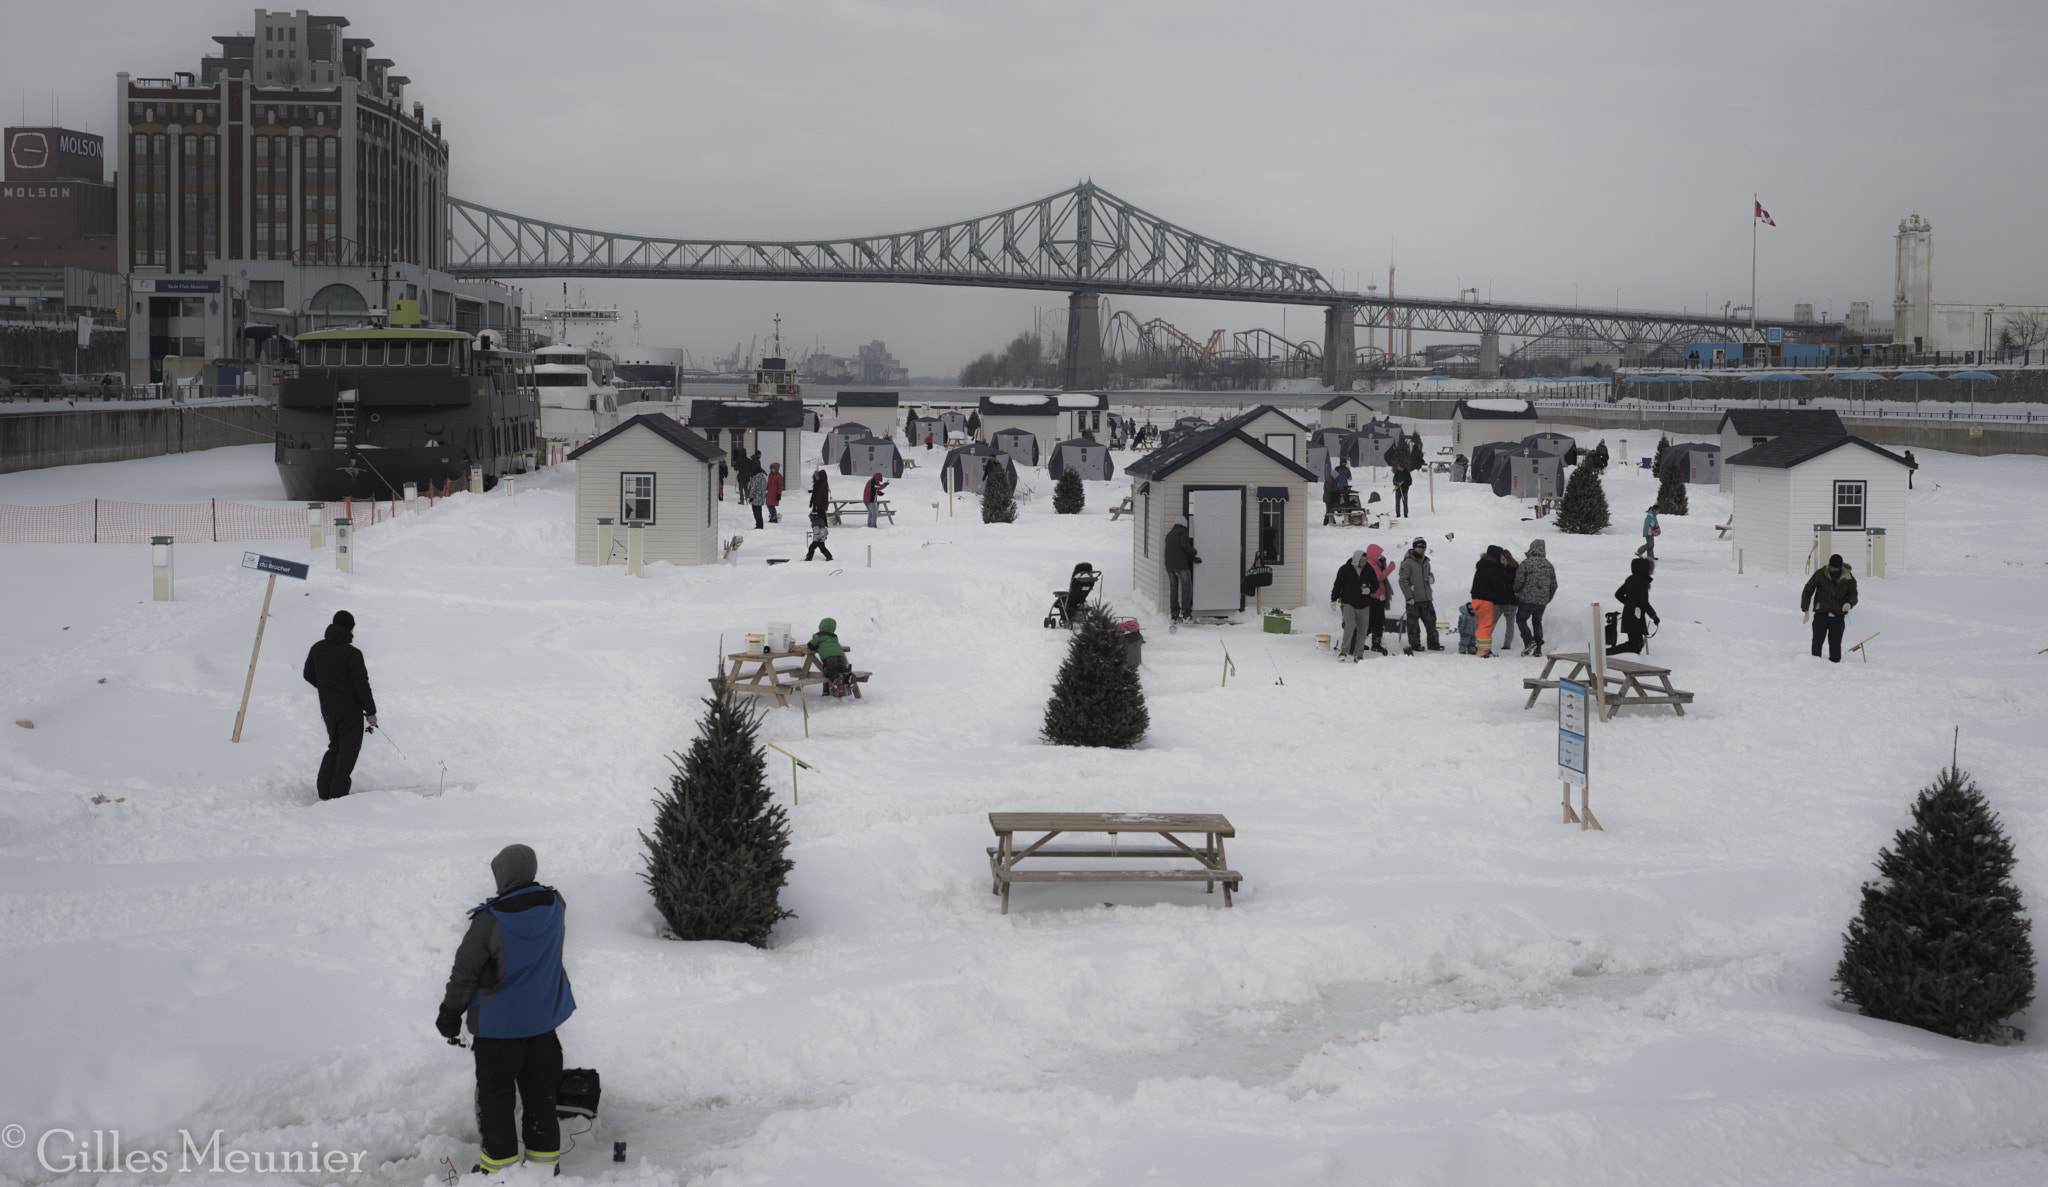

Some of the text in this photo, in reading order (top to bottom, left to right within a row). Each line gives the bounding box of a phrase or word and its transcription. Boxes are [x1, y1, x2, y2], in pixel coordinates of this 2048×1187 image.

[60, 135, 104, 158] MOLSON
[4, 187, 70, 198] MOLSON
[268, 563, 291, 573] Brochet
